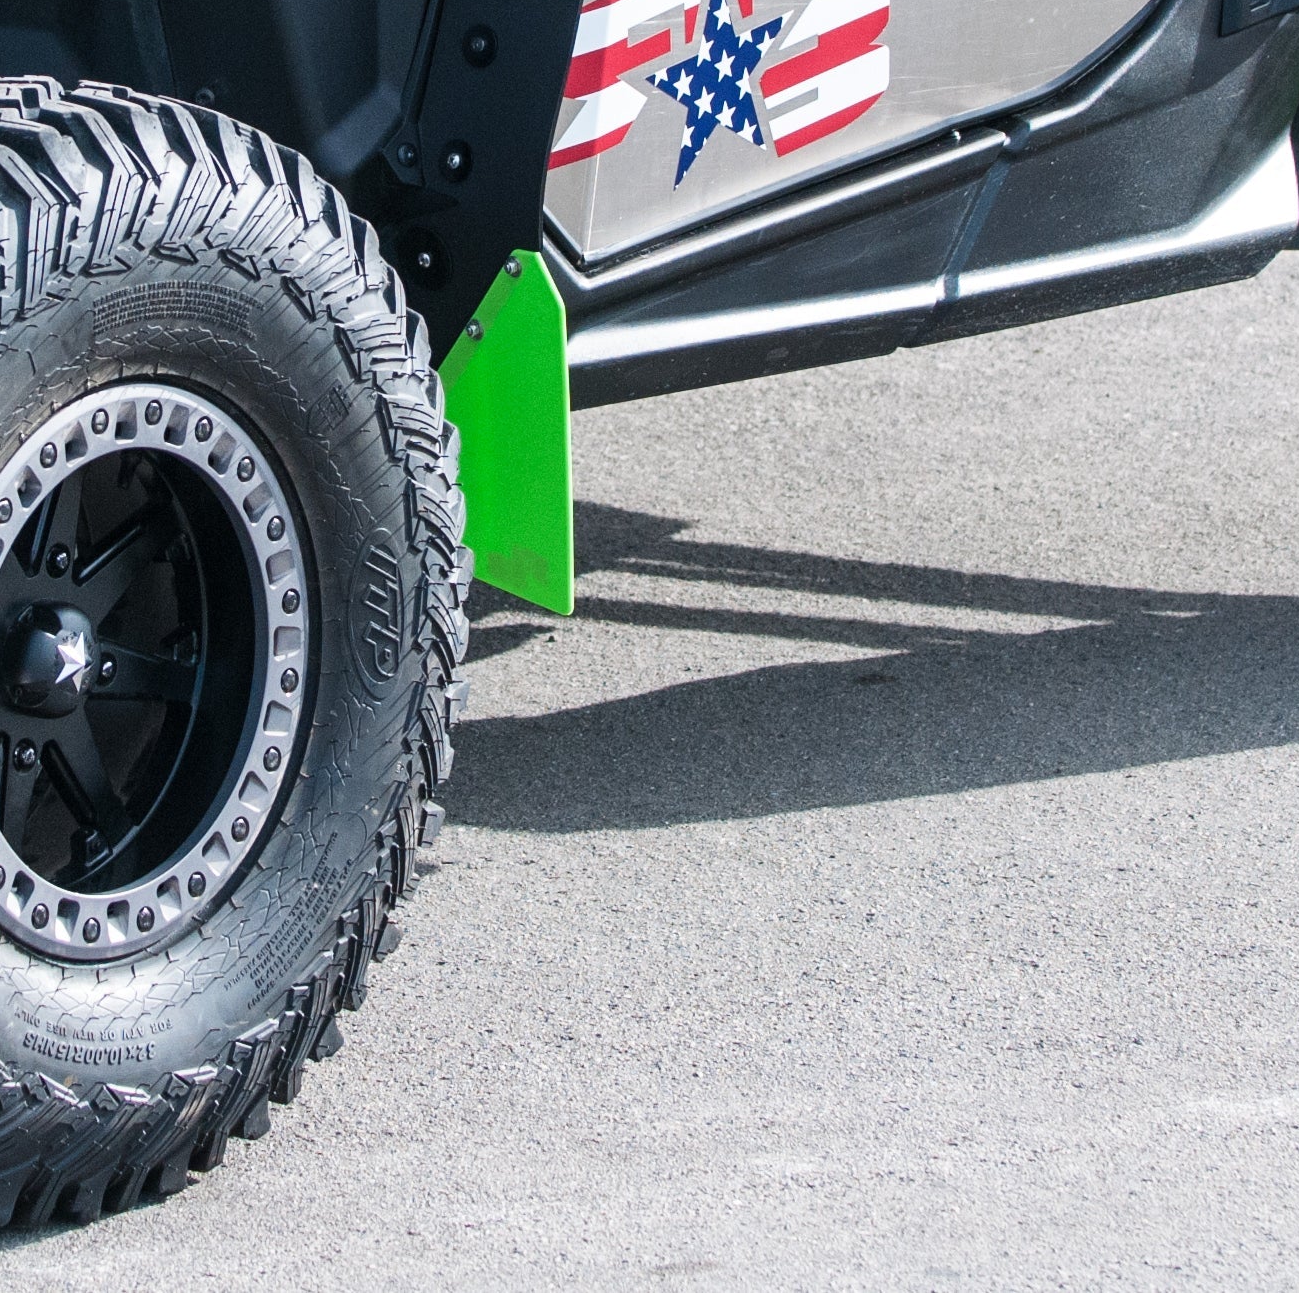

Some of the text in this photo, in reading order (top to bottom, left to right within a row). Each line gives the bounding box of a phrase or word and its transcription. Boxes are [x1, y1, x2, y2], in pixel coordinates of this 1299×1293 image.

[364, 544, 401, 677] ITP
[122, 1025, 146, 1041] ATV
[149, 1018, 174, 1035] FOR
[101, 1029, 116, 1042] OR
